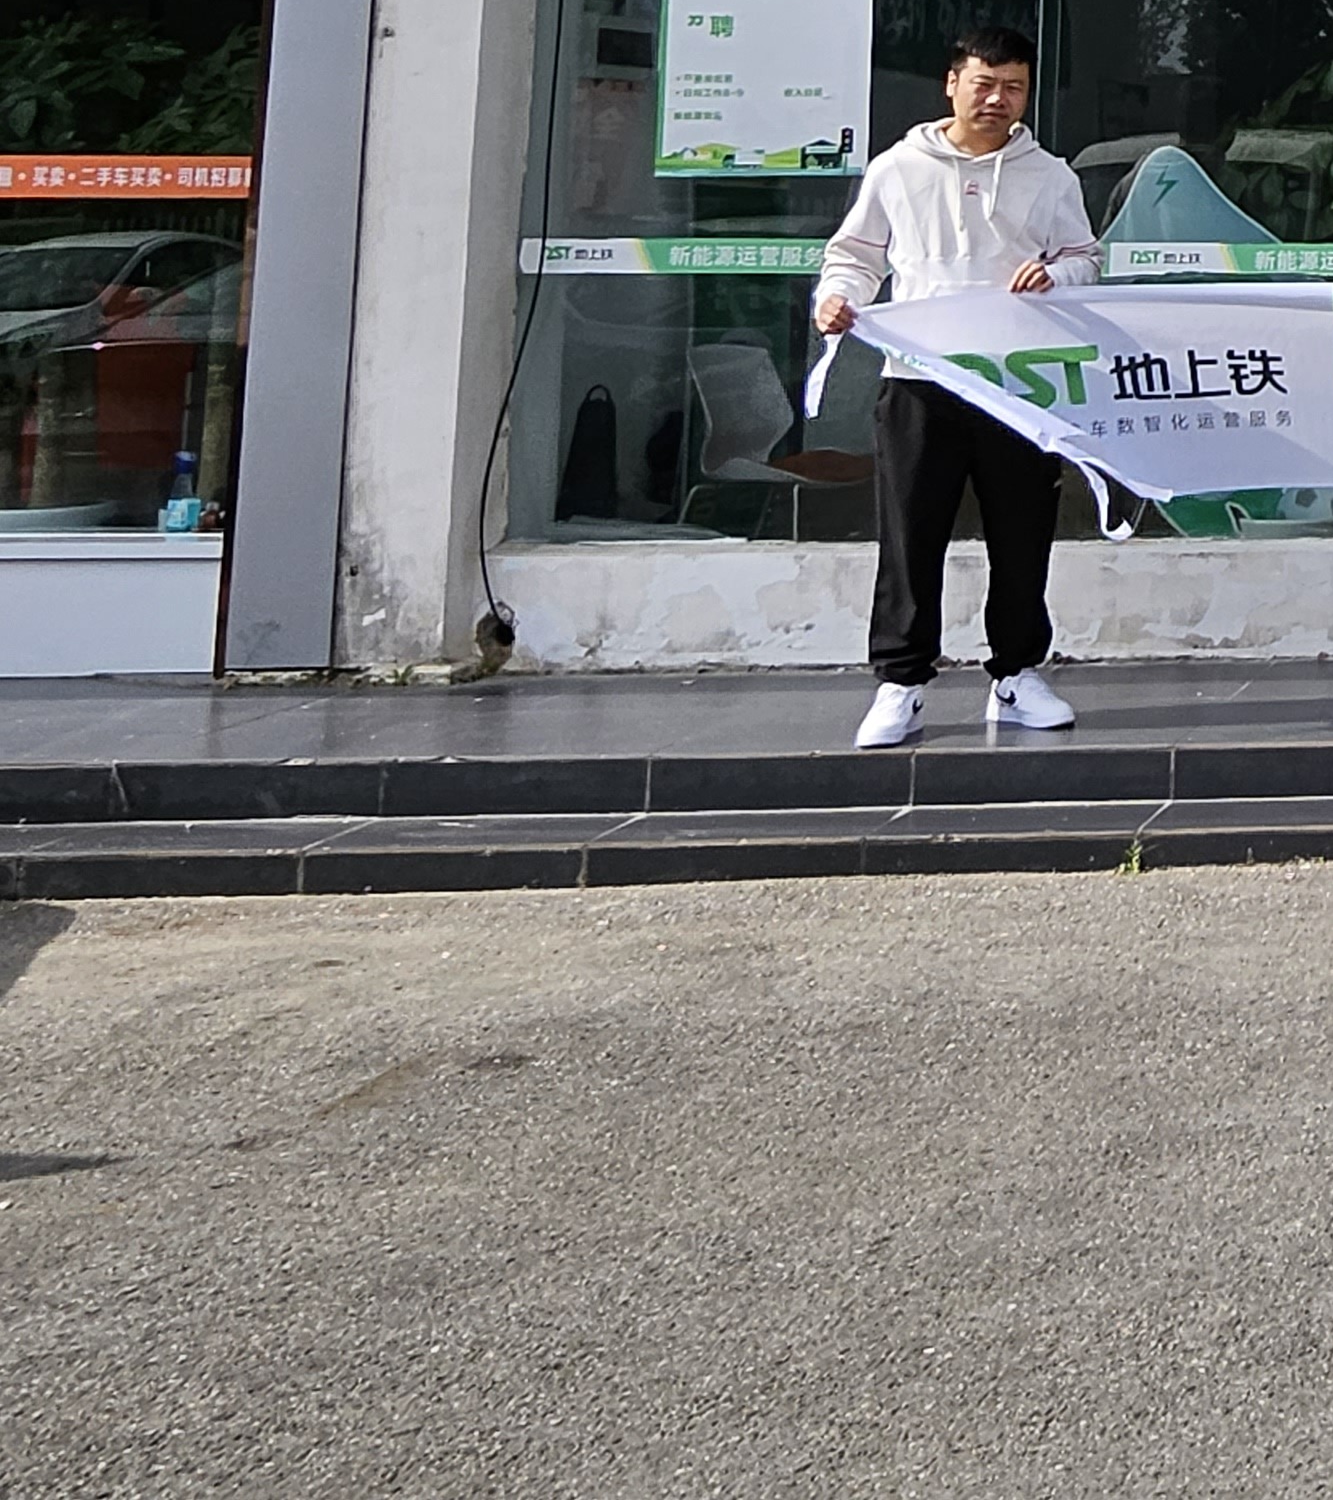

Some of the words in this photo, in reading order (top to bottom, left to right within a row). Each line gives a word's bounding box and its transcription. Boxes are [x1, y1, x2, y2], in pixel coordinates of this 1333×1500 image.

[1130, 250, 1160, 264] DST
[1109, 349, 1289, 401] 地上铁
[1070, 409, 1293, 439] 车数智化运营服务
